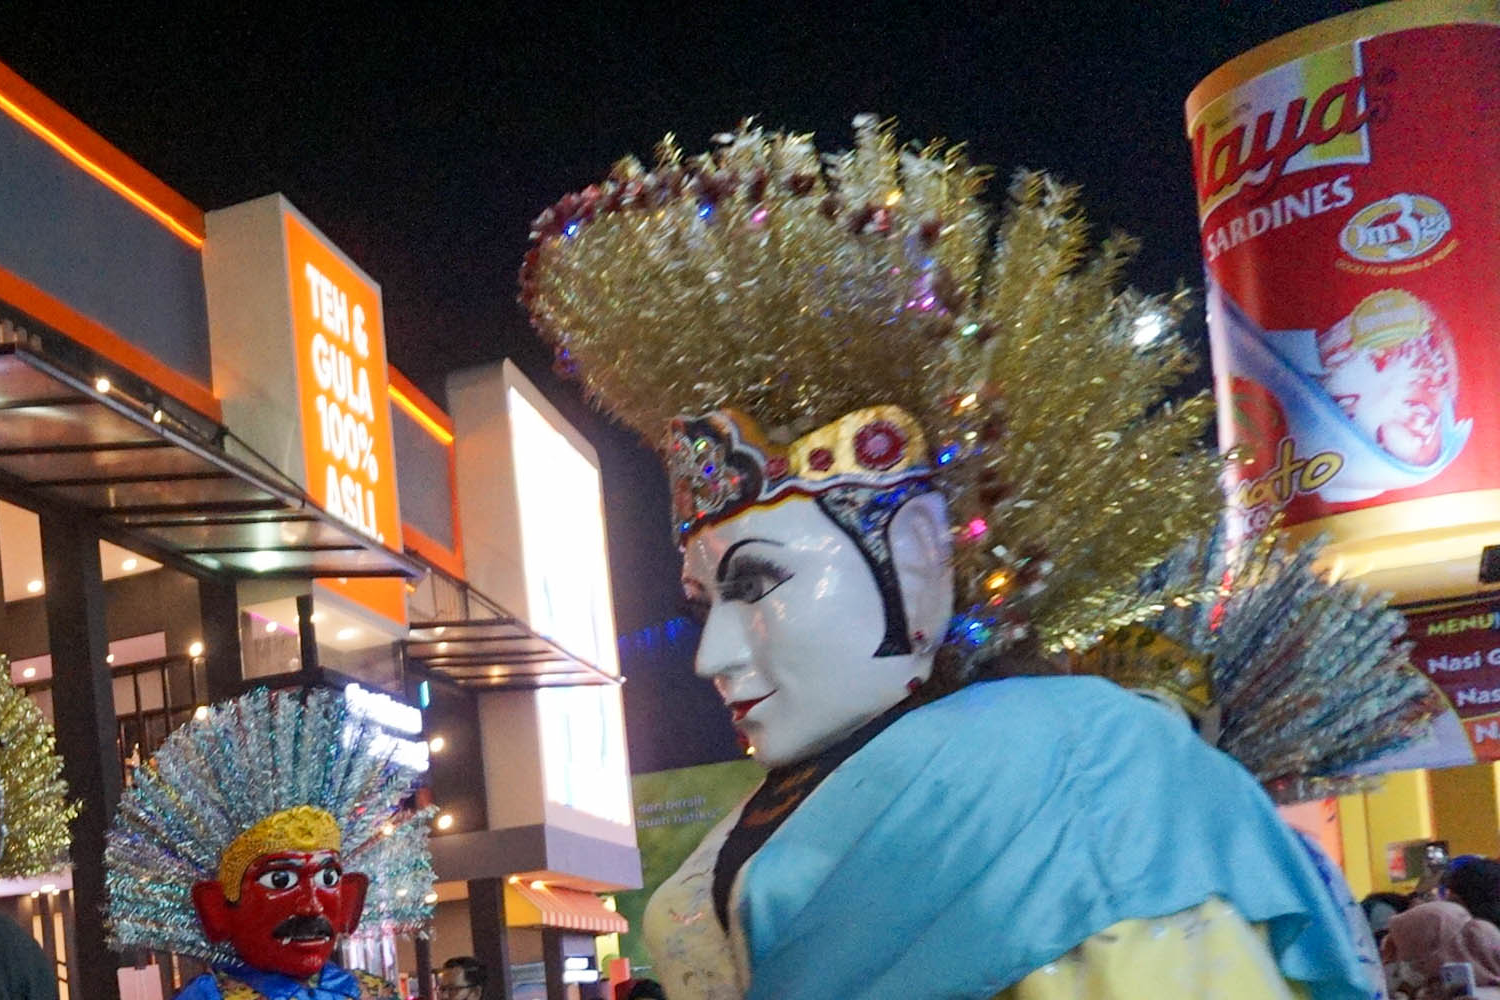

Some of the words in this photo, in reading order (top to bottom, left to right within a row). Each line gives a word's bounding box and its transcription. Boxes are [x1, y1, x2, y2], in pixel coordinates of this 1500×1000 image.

[1205, 173, 1355, 263] SARDINES
[305, 262, 350, 345] TEH
[352, 304, 370, 359] &
[311, 332, 375, 423] GULA
[316, 394, 379, 484] 100%
[1427, 651, 1482, 674] Nasi
